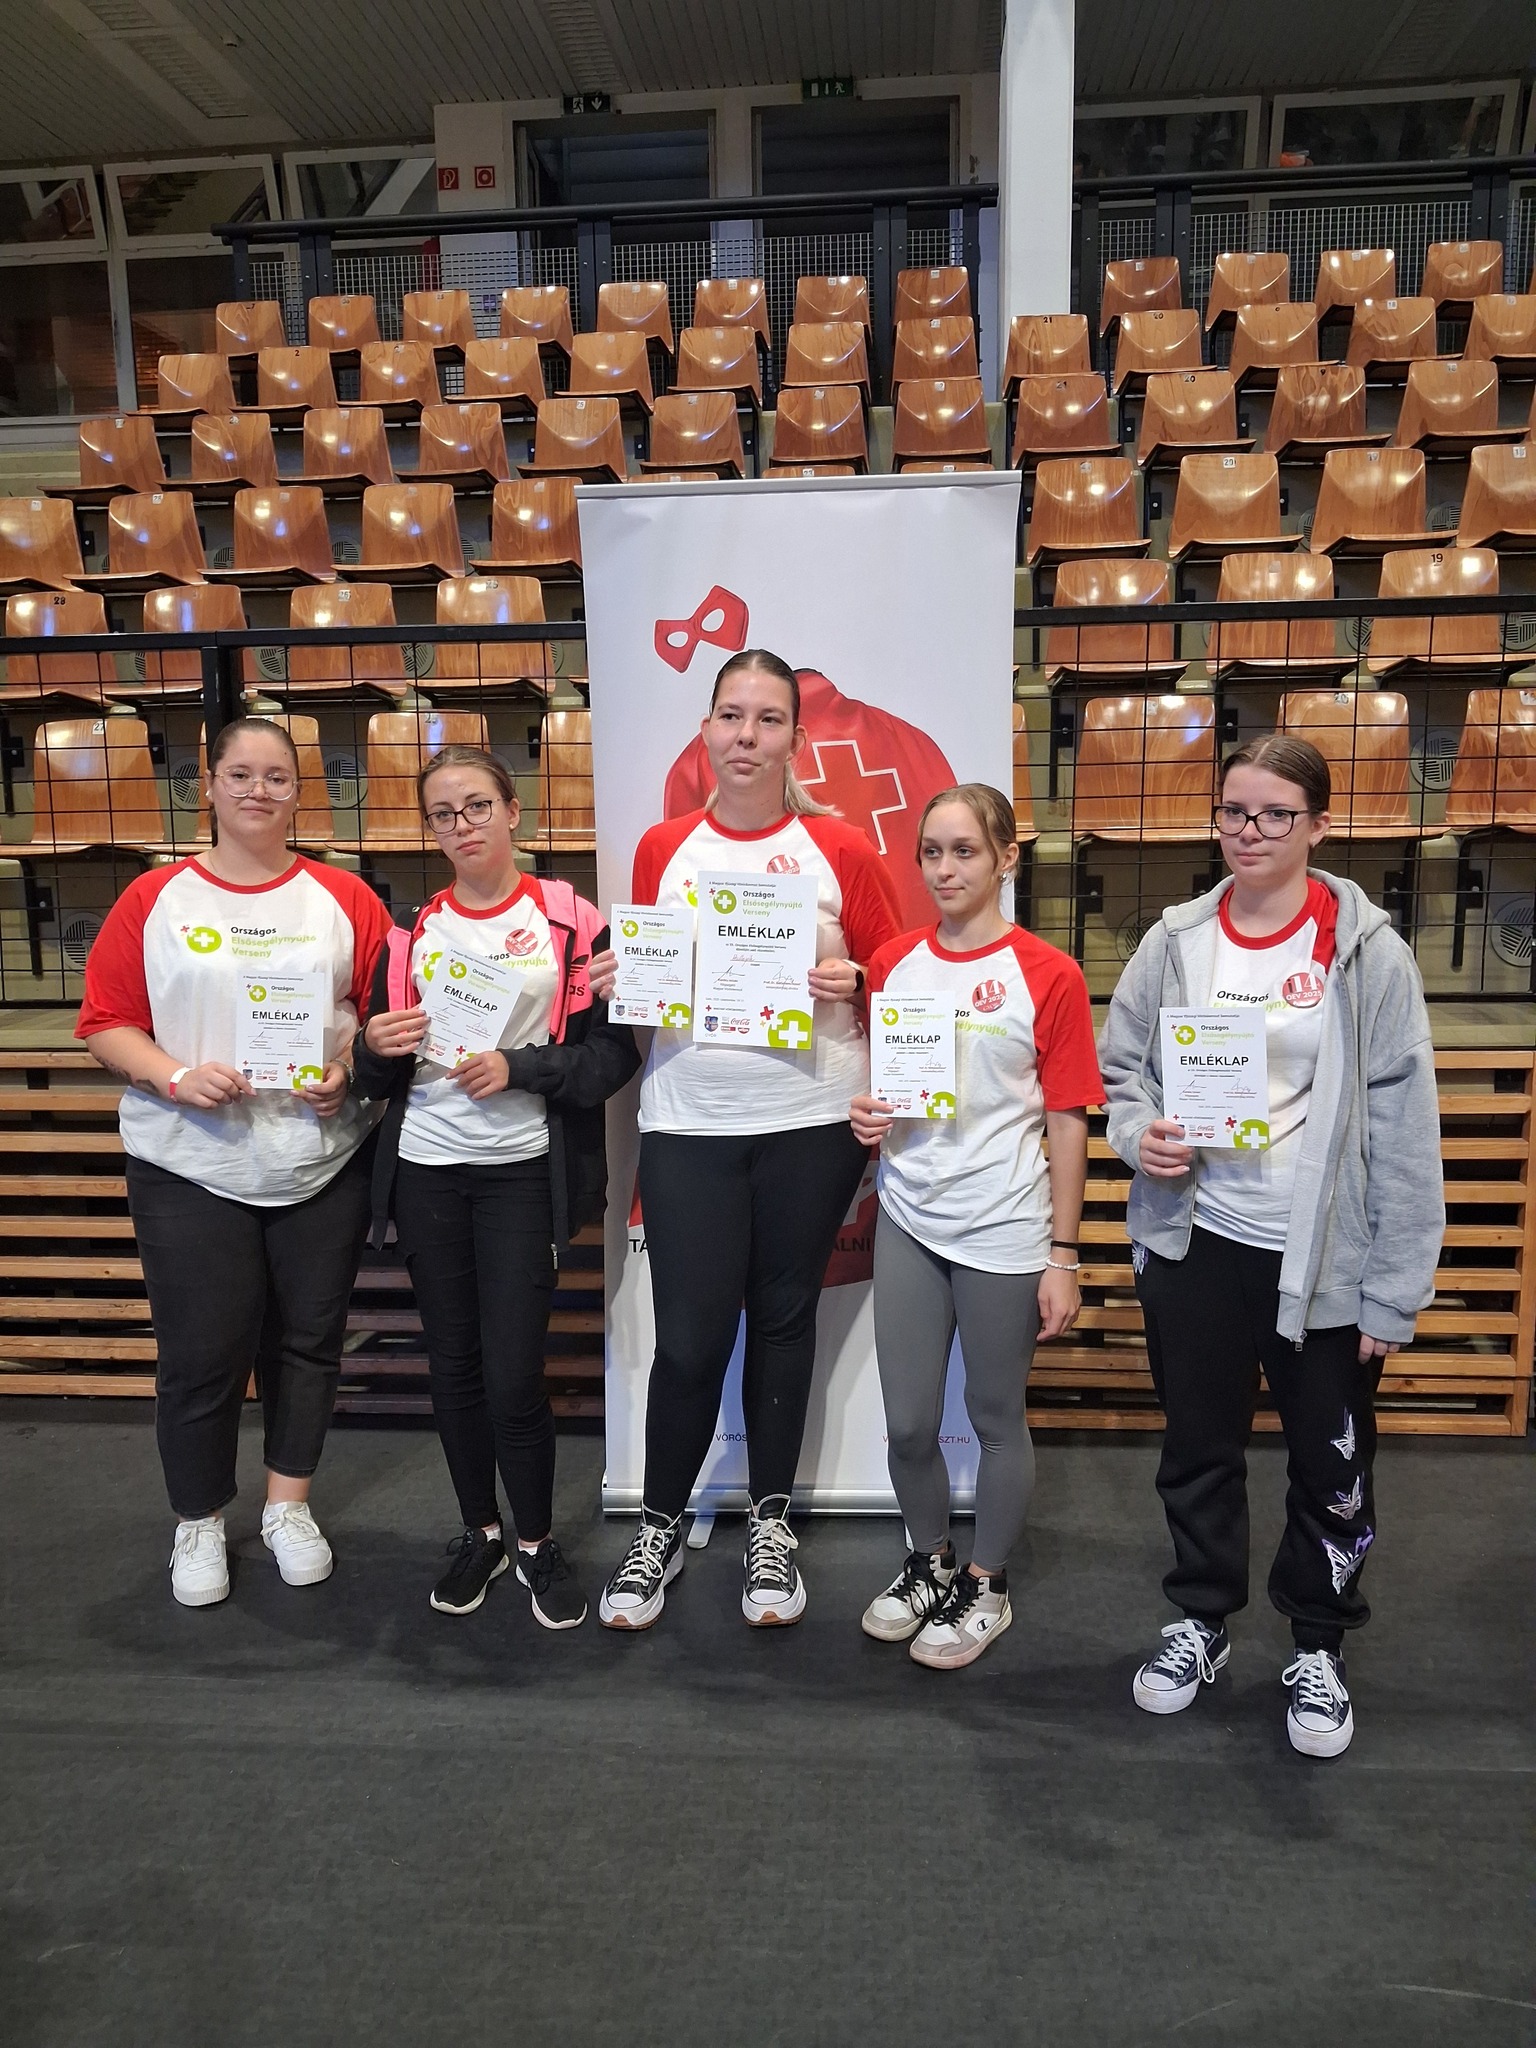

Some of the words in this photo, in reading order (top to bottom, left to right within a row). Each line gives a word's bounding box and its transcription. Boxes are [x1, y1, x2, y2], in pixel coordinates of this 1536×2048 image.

[1043, 316, 1052, 324] 21
[1224, 458, 1234, 466] 20
[1430, 553, 1443, 563] 19
[54, 596, 66, 605] 28
[742, 890, 776, 900] Országos
[742, 908, 771, 918] Verseny
[230, 926, 277, 938] Országos
[718, 924, 796, 940] EMLÉKLAP
[232, 946, 272, 958] Verseny
[624, 946, 680, 958] EMLÉKLAP
[444, 984, 498, 1013] EMLÉKLAP
[1216, 990, 1269, 1004] Országos
[252, 1010, 310, 1021] EMLÉKLAP
[1200, 1024, 1230, 1032] Országos
[885, 1033, 942, 1044] EMLÉKLAP
[1180, 1054, 1250, 1067] EMLÉKLAP
